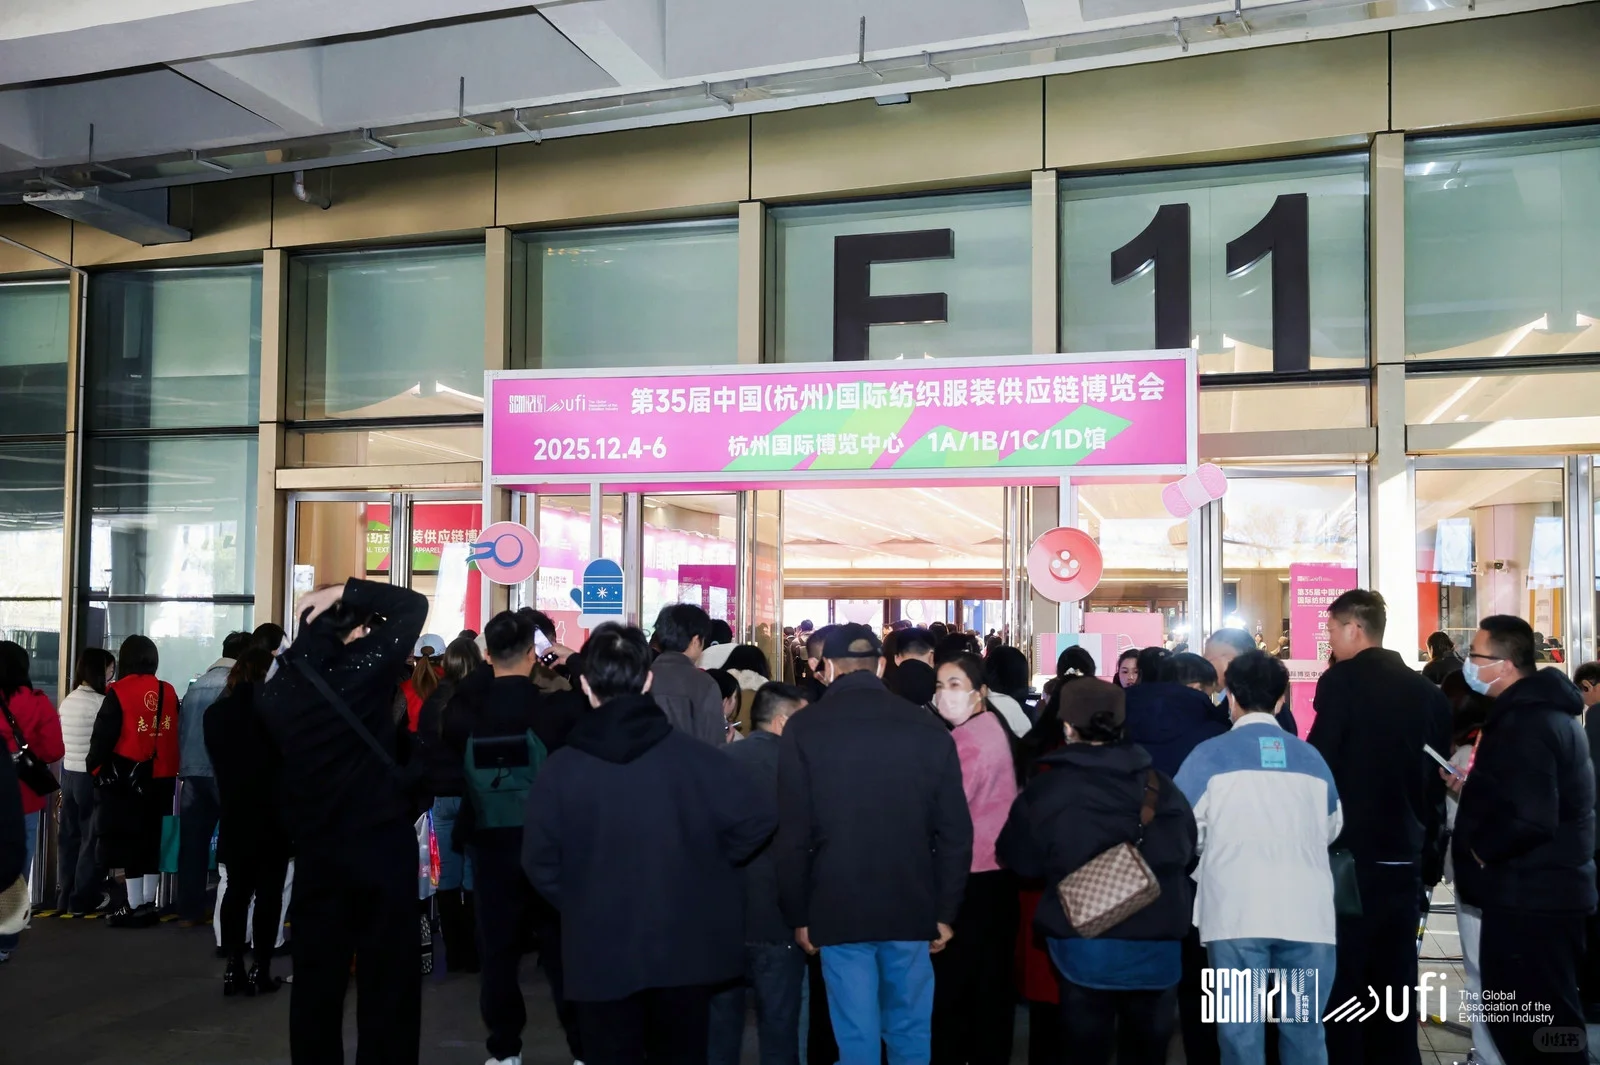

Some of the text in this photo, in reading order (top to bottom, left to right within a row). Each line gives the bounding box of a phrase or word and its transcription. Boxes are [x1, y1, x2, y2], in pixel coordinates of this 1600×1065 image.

[1111, 193, 1311, 372] 11
[565, 395, 586, 411] ufi
[630, 371, 1165, 415] 第35届中国(杭州)国际纺织服装供应链博览会
[533, 426, 1107, 461] 2025.12.4-6 杭州国际博览中心 1A/1B/1C/1D馆
[413, 529, 481, 544] 装供应链博
